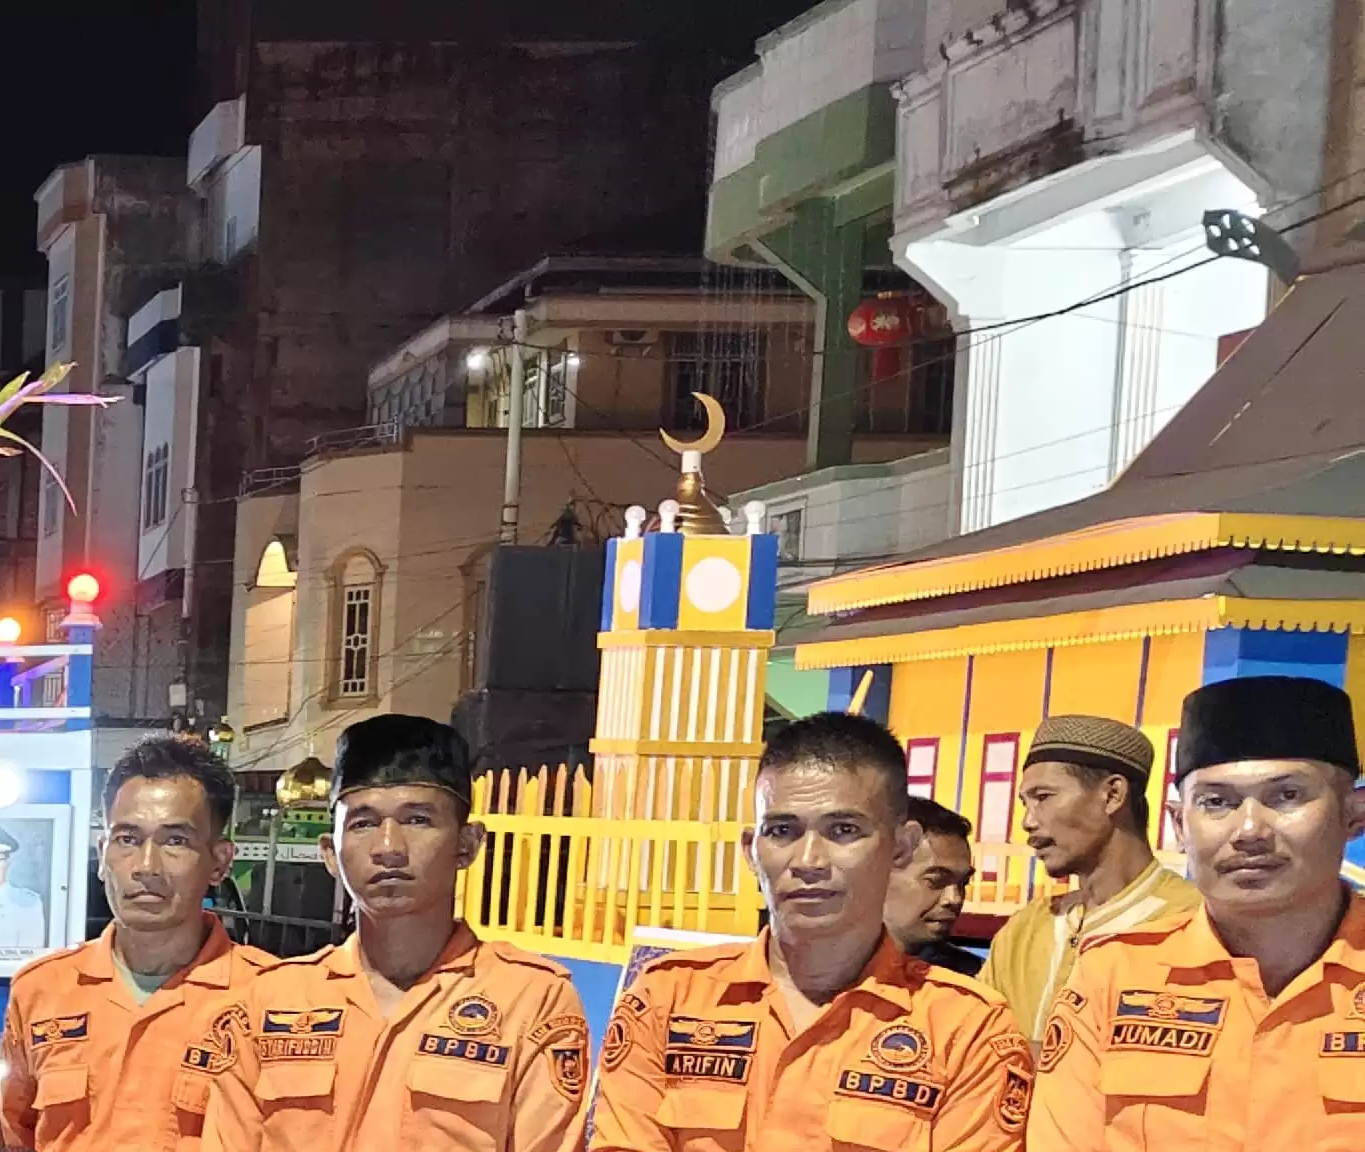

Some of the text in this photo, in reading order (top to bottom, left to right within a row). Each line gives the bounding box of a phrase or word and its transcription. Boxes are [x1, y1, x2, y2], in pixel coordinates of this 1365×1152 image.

[425, 1037, 499, 1062] BPBD
[1113, 1025, 1208, 1050] JUMADI
[672, 1055, 735, 1077] ARIFIN
[846, 1071, 928, 1104] BPBD
